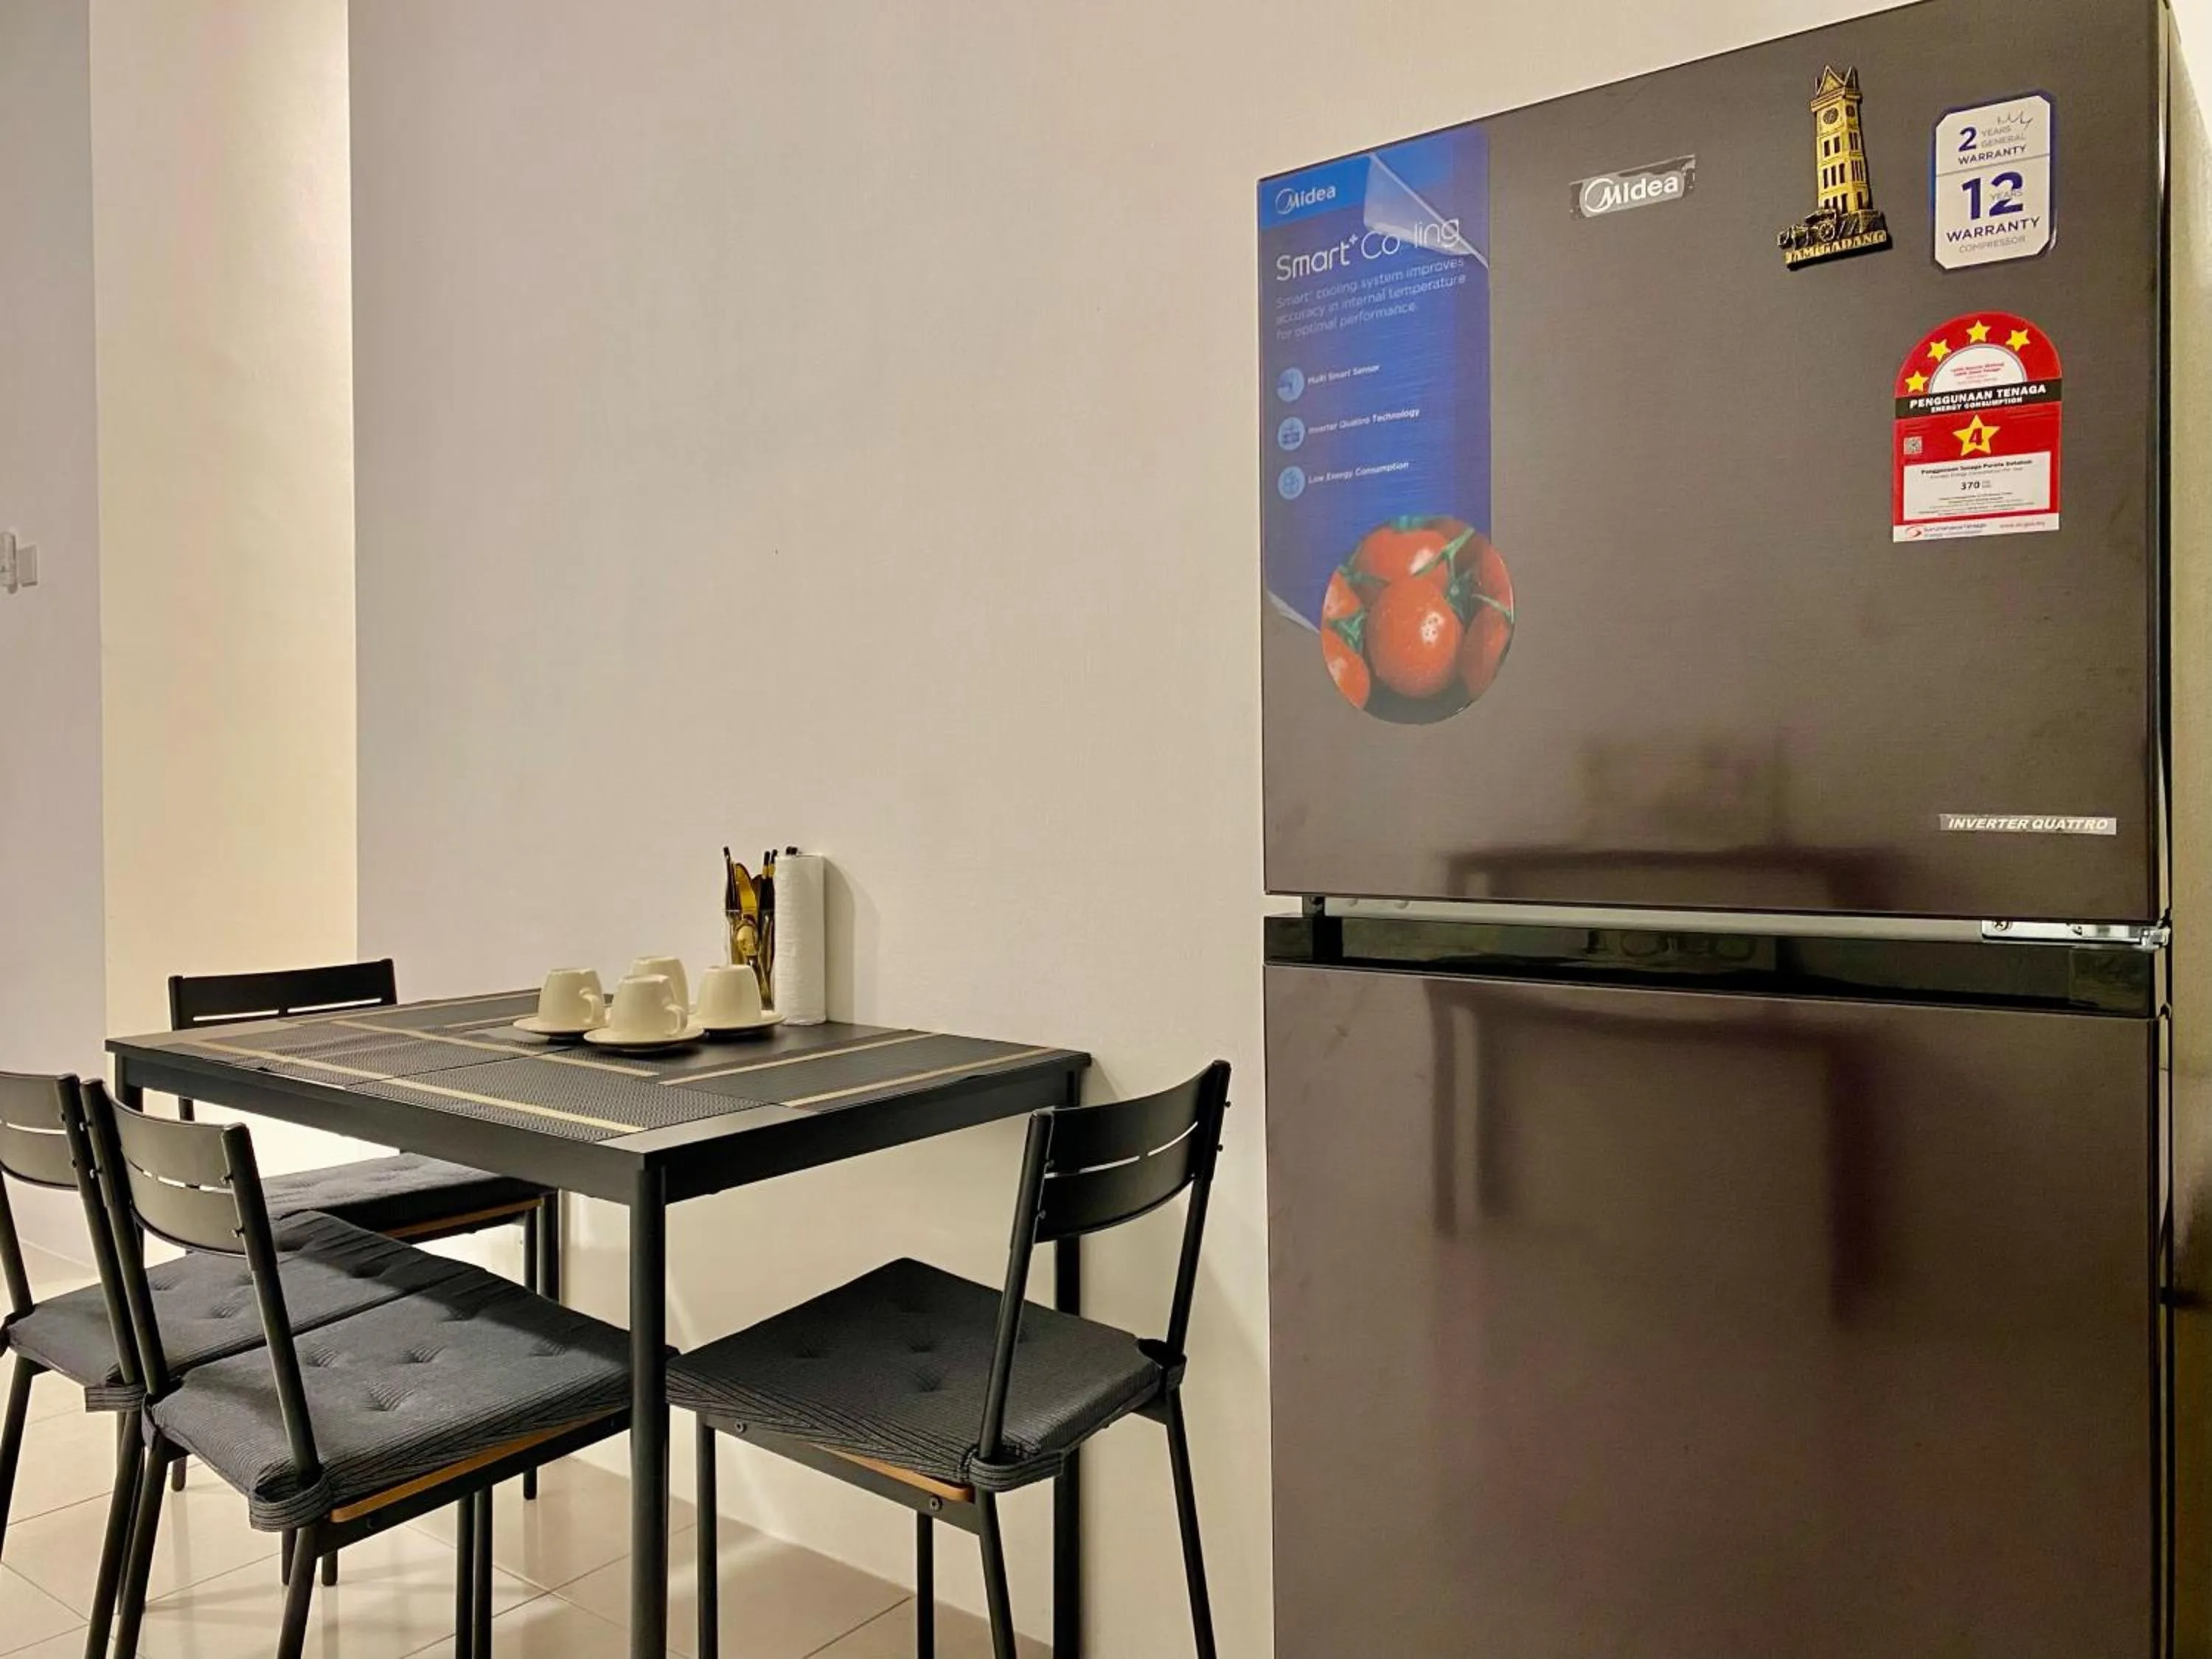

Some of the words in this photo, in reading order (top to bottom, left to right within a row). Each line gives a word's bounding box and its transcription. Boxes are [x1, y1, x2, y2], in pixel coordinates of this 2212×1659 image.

[1958, 126, 1977, 152] 2
[1958, 144, 2027, 165] WARRANTY
[1275, 185, 1336, 215] Midea
[1585, 176, 1679, 212] Midea
[1961, 171, 2024, 220] 12
[1947, 216, 2041, 243] WARRANTY
[1406, 258, 1465, 279] improves
[1388, 274, 1467, 298] temperature
[1910, 391, 1992, 409] PENGGUNAAN
[1996, 384, 2046, 398] TENAGA
[1931, 403, 1962, 414] ENERGY
[1964, 397, 2023, 409] CONSUMPTION
[1372, 408, 1420, 423] Technology
[1969, 428, 1983, 446] 4
[1354, 461, 1409, 476] Consumption
[1961, 481, 1980, 490] 370
[1948, 818, 2029, 830] INVERTER
[2031, 818, 2108, 830] QUATTRO
